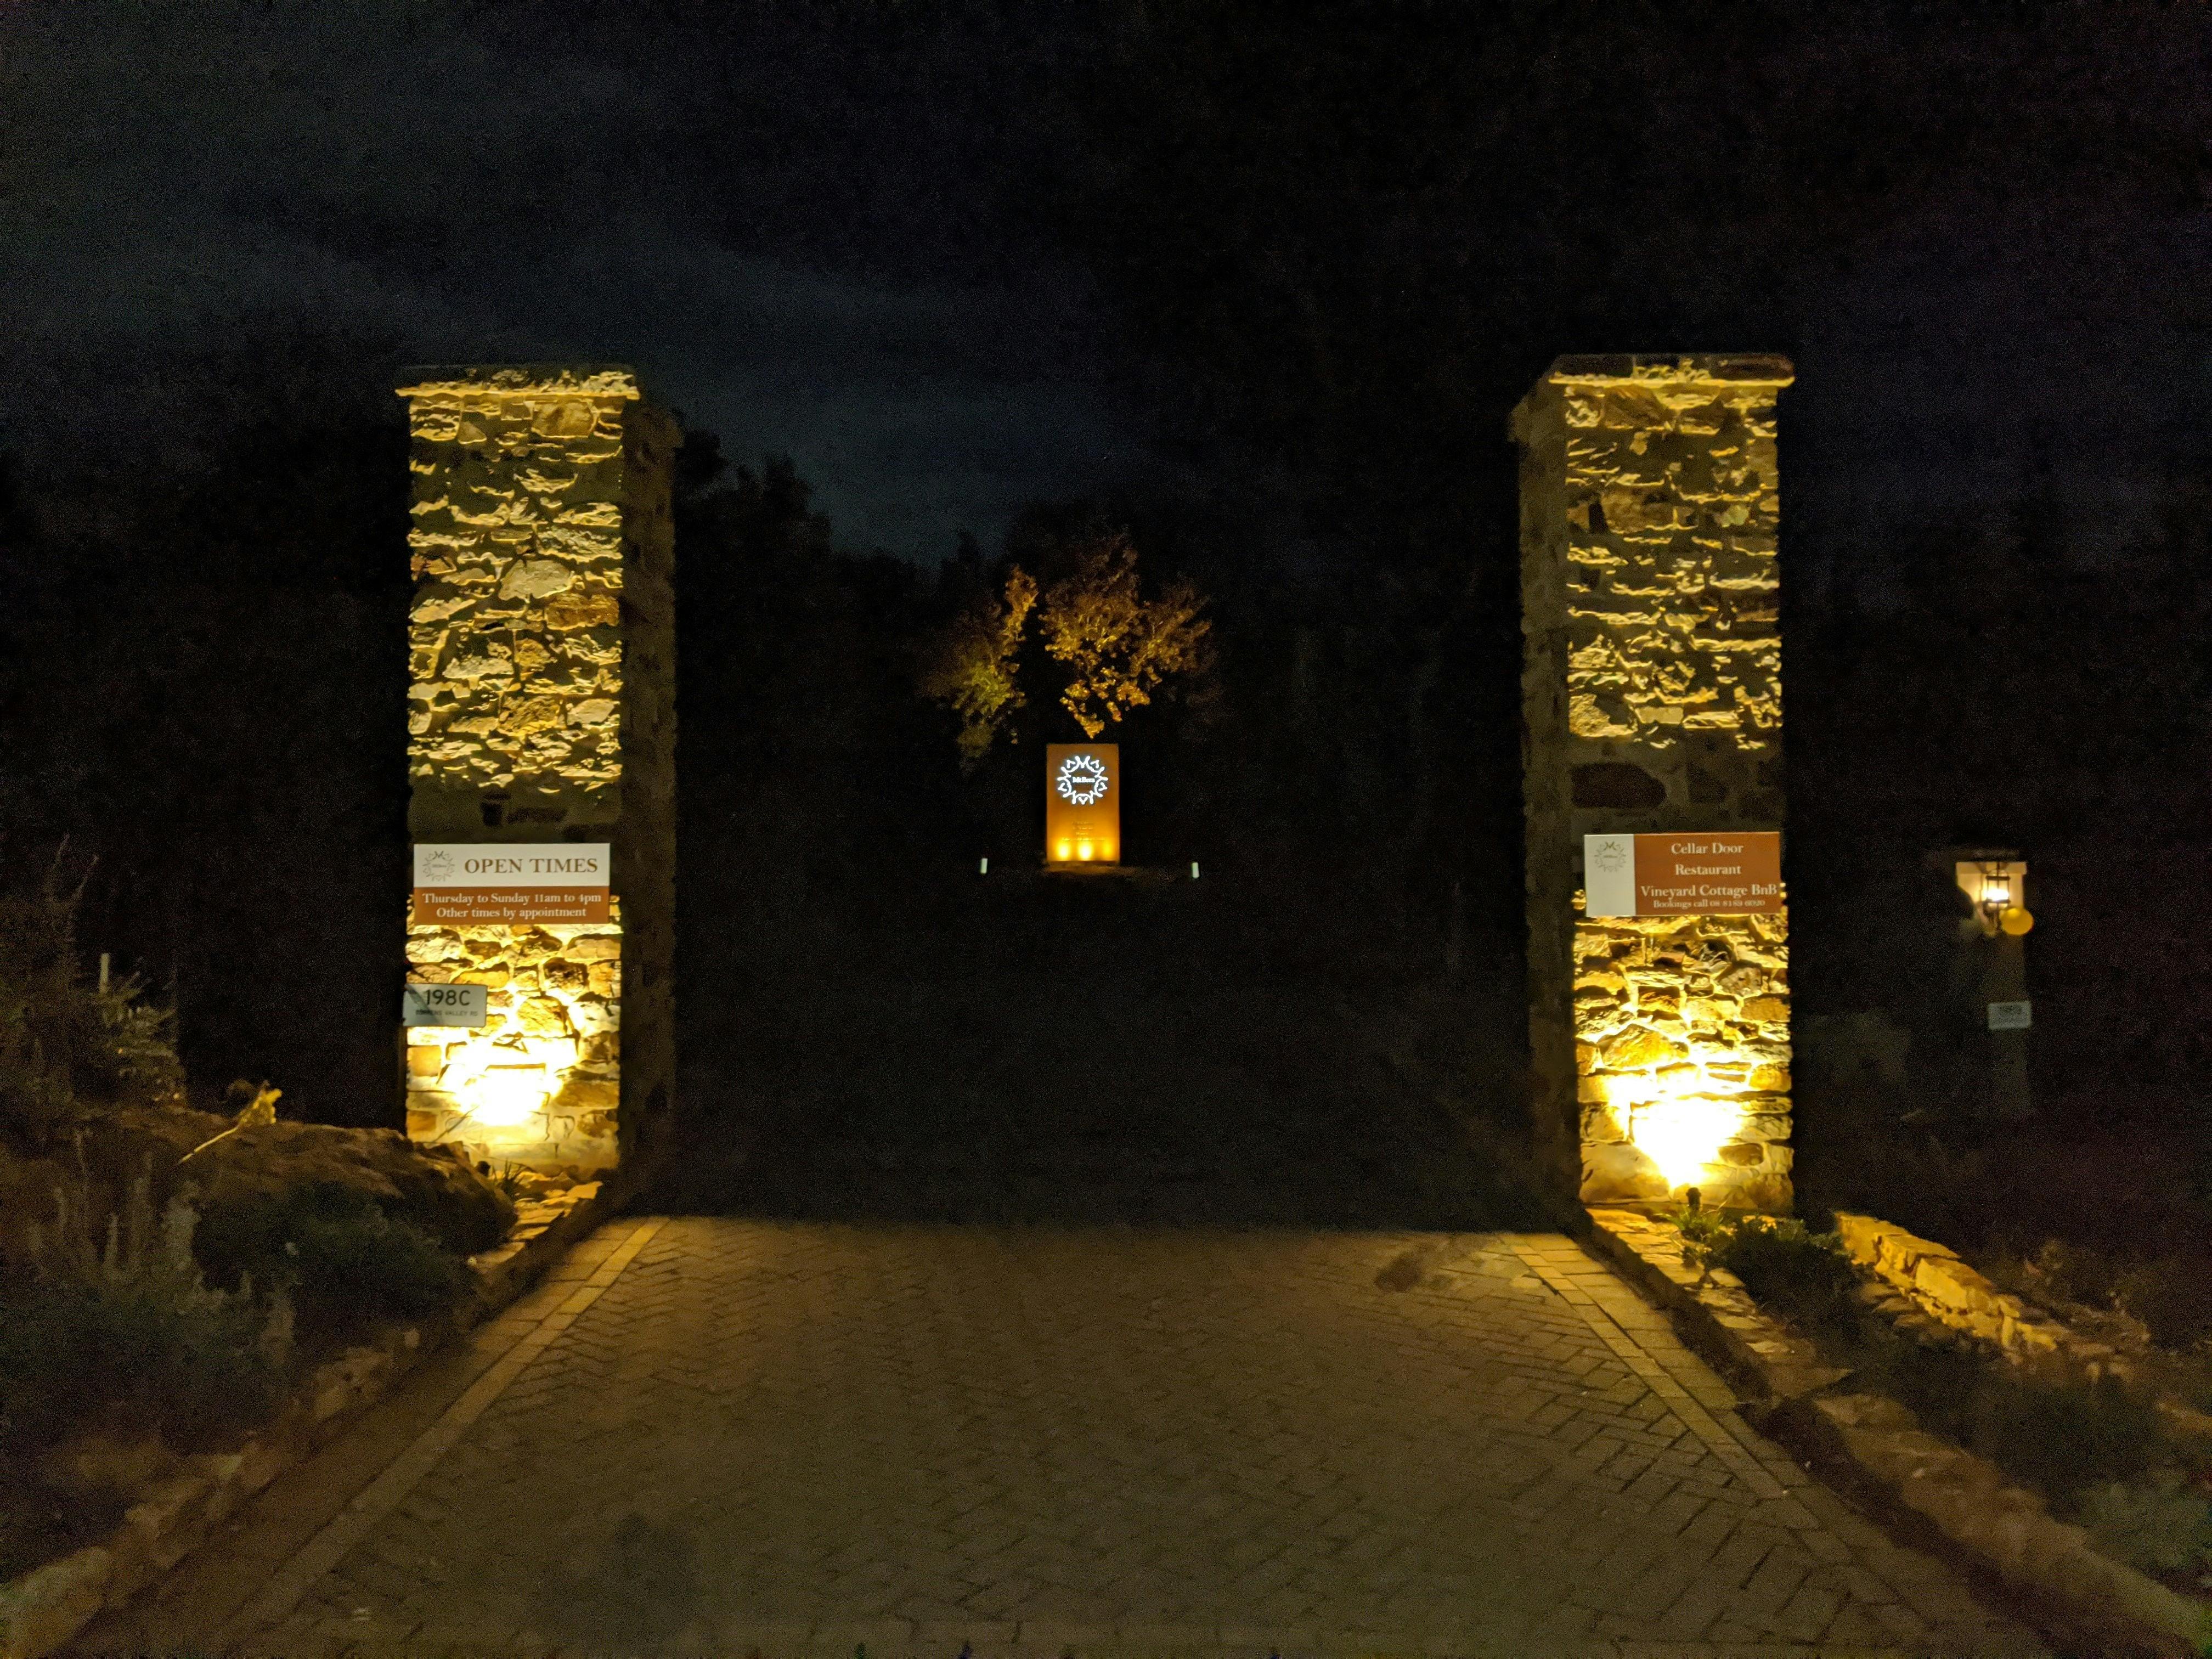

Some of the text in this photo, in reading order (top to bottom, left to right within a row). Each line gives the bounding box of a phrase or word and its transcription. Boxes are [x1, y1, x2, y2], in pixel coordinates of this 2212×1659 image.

[1671, 843, 1744, 854] Cellar Door
[465, 857, 598, 873] OPEN TIMES
[1675, 864, 1741, 876] Restaurant
[1641, 884, 1778, 900] Vineyard Cottage BnB
[422, 893, 602, 905] Thursday to Sunday 11am to 4pm
[1654, 900, 1691, 910] Bookings
[1694, 899, 1708, 908] call
[436, 907, 586, 919] Other times by appointment
[425, 990, 471, 1006] 198C
